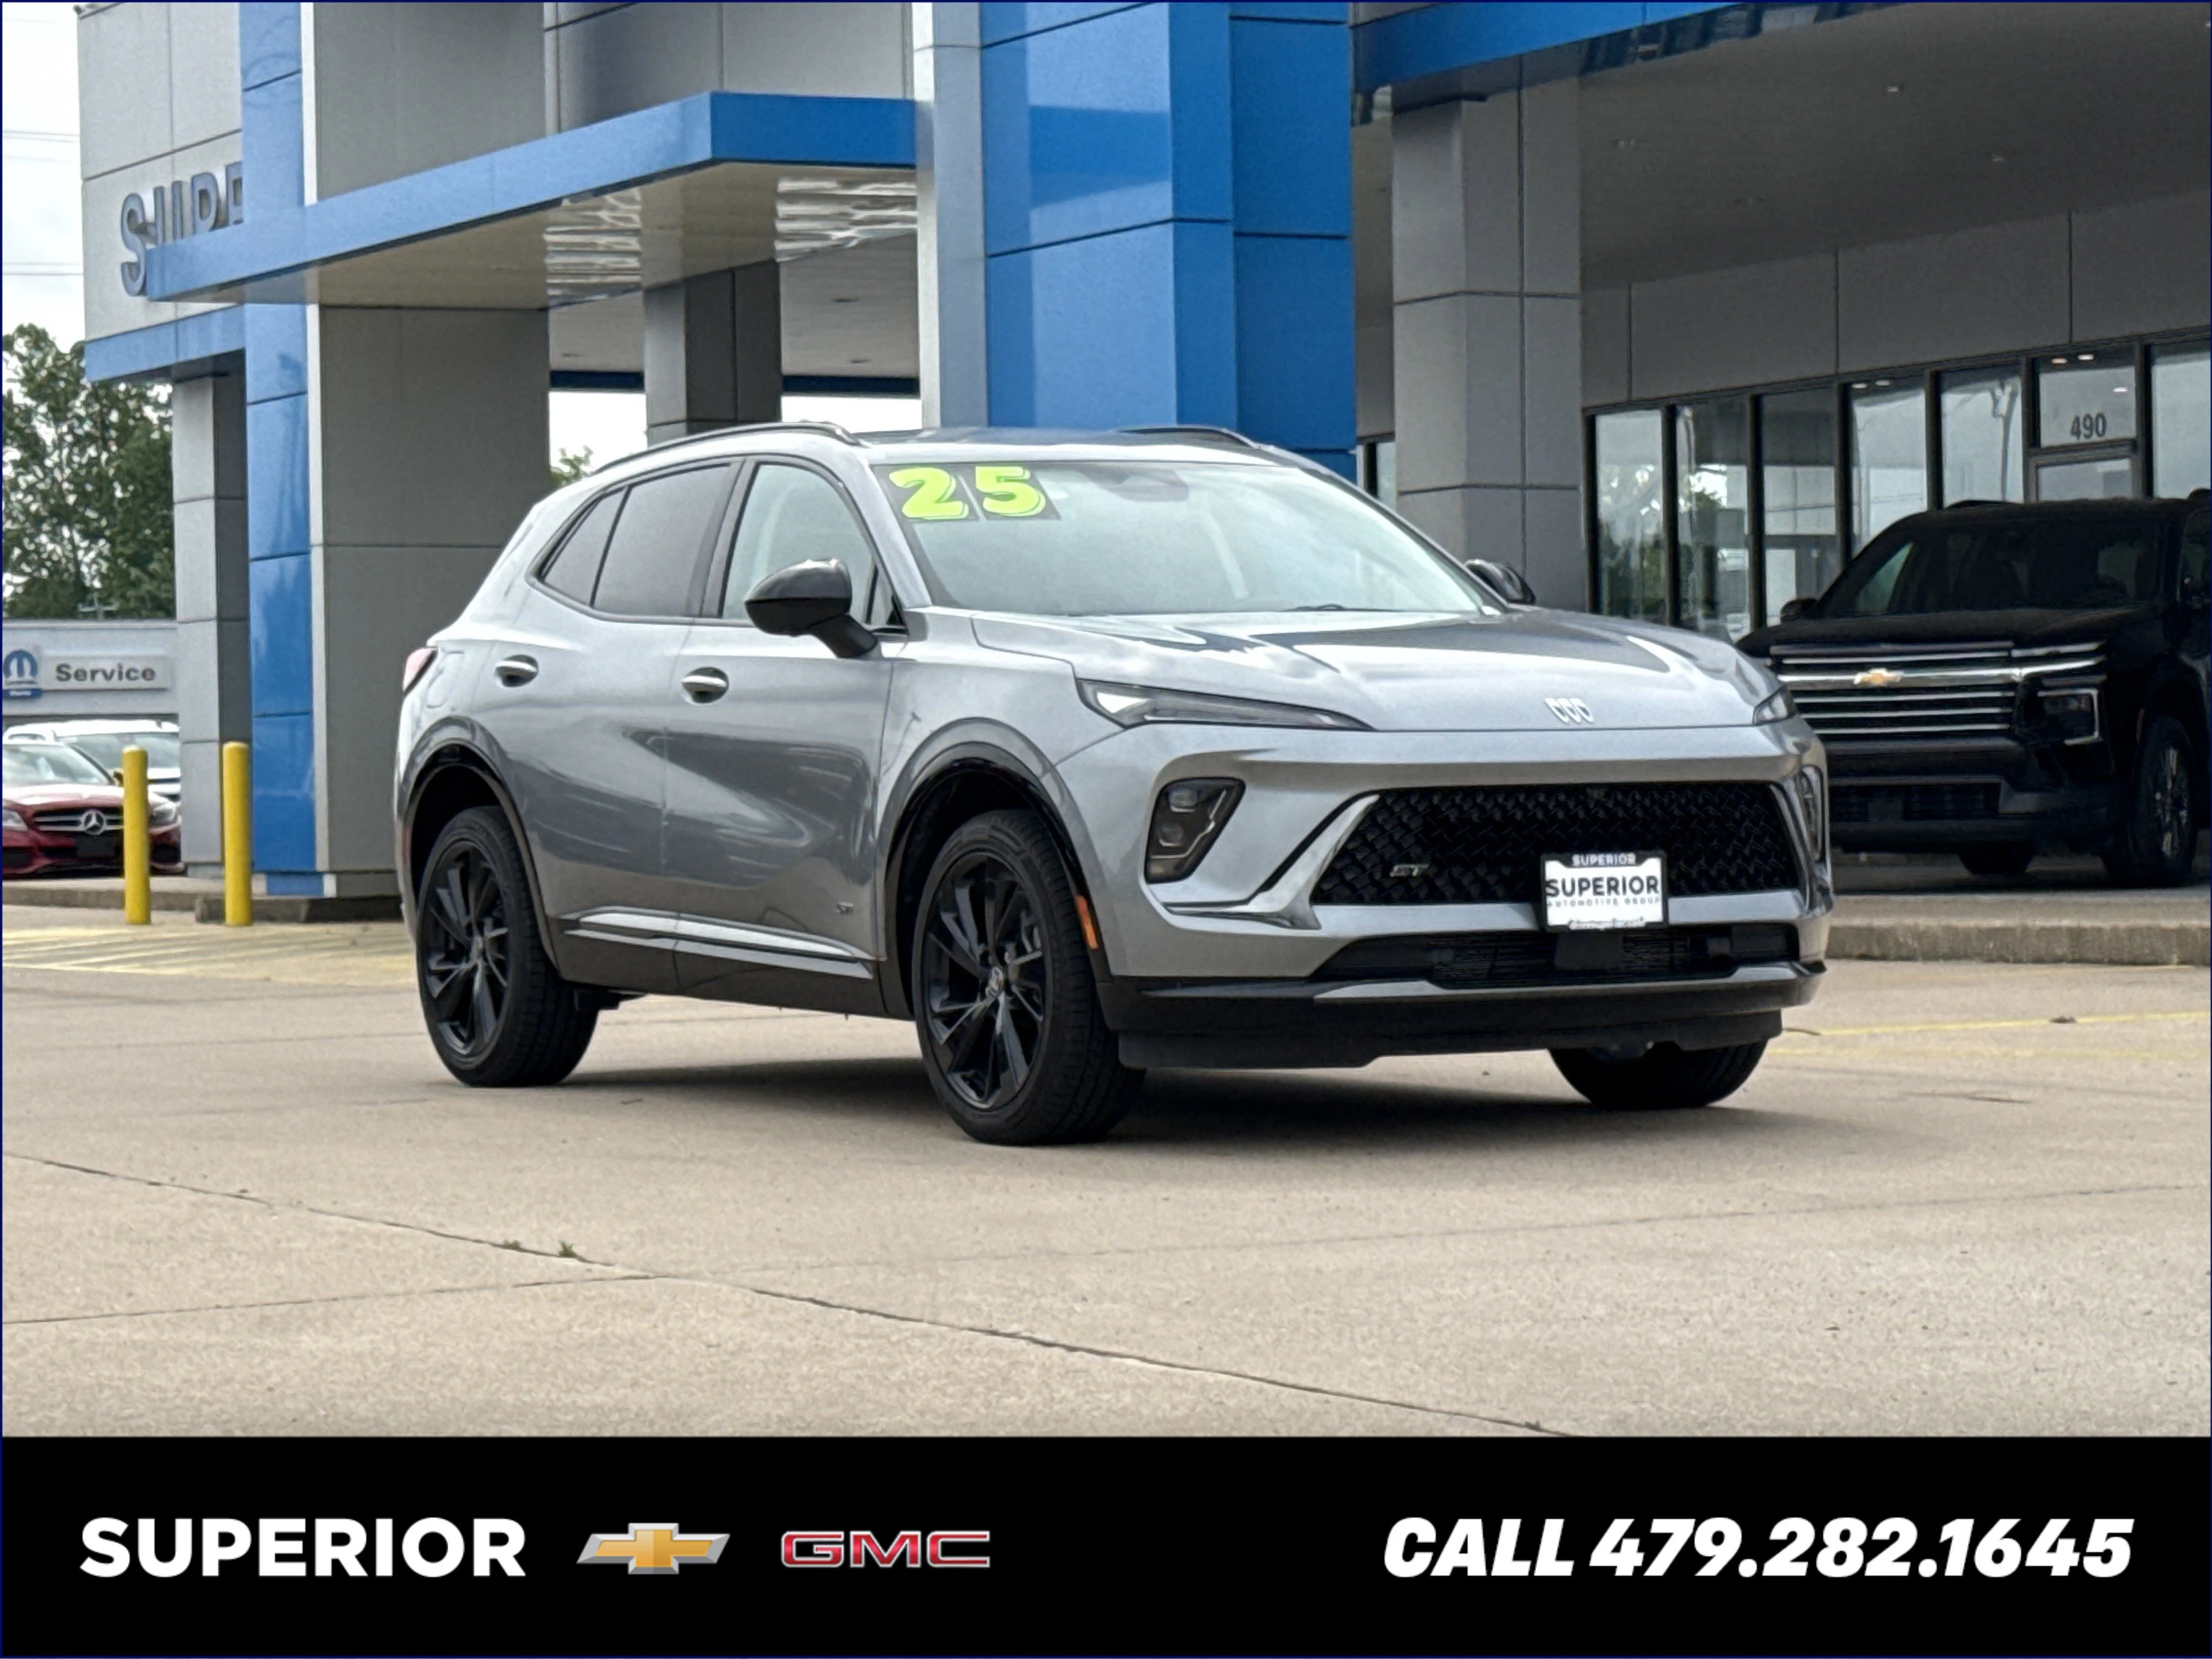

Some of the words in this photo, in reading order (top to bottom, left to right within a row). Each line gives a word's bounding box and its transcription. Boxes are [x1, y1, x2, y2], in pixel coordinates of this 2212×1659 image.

[2069, 412, 2107, 440] 490
[888, 465, 1047, 521] 25
[55, 662, 156, 682] Service
[1571, 852, 1636, 866] SUPERIOR
[1545, 875, 1660, 897] SUPERIOR
[1547, 898, 1620, 908] AUTOMOTIVE
[1624, 896, 1660, 906] GROUP
